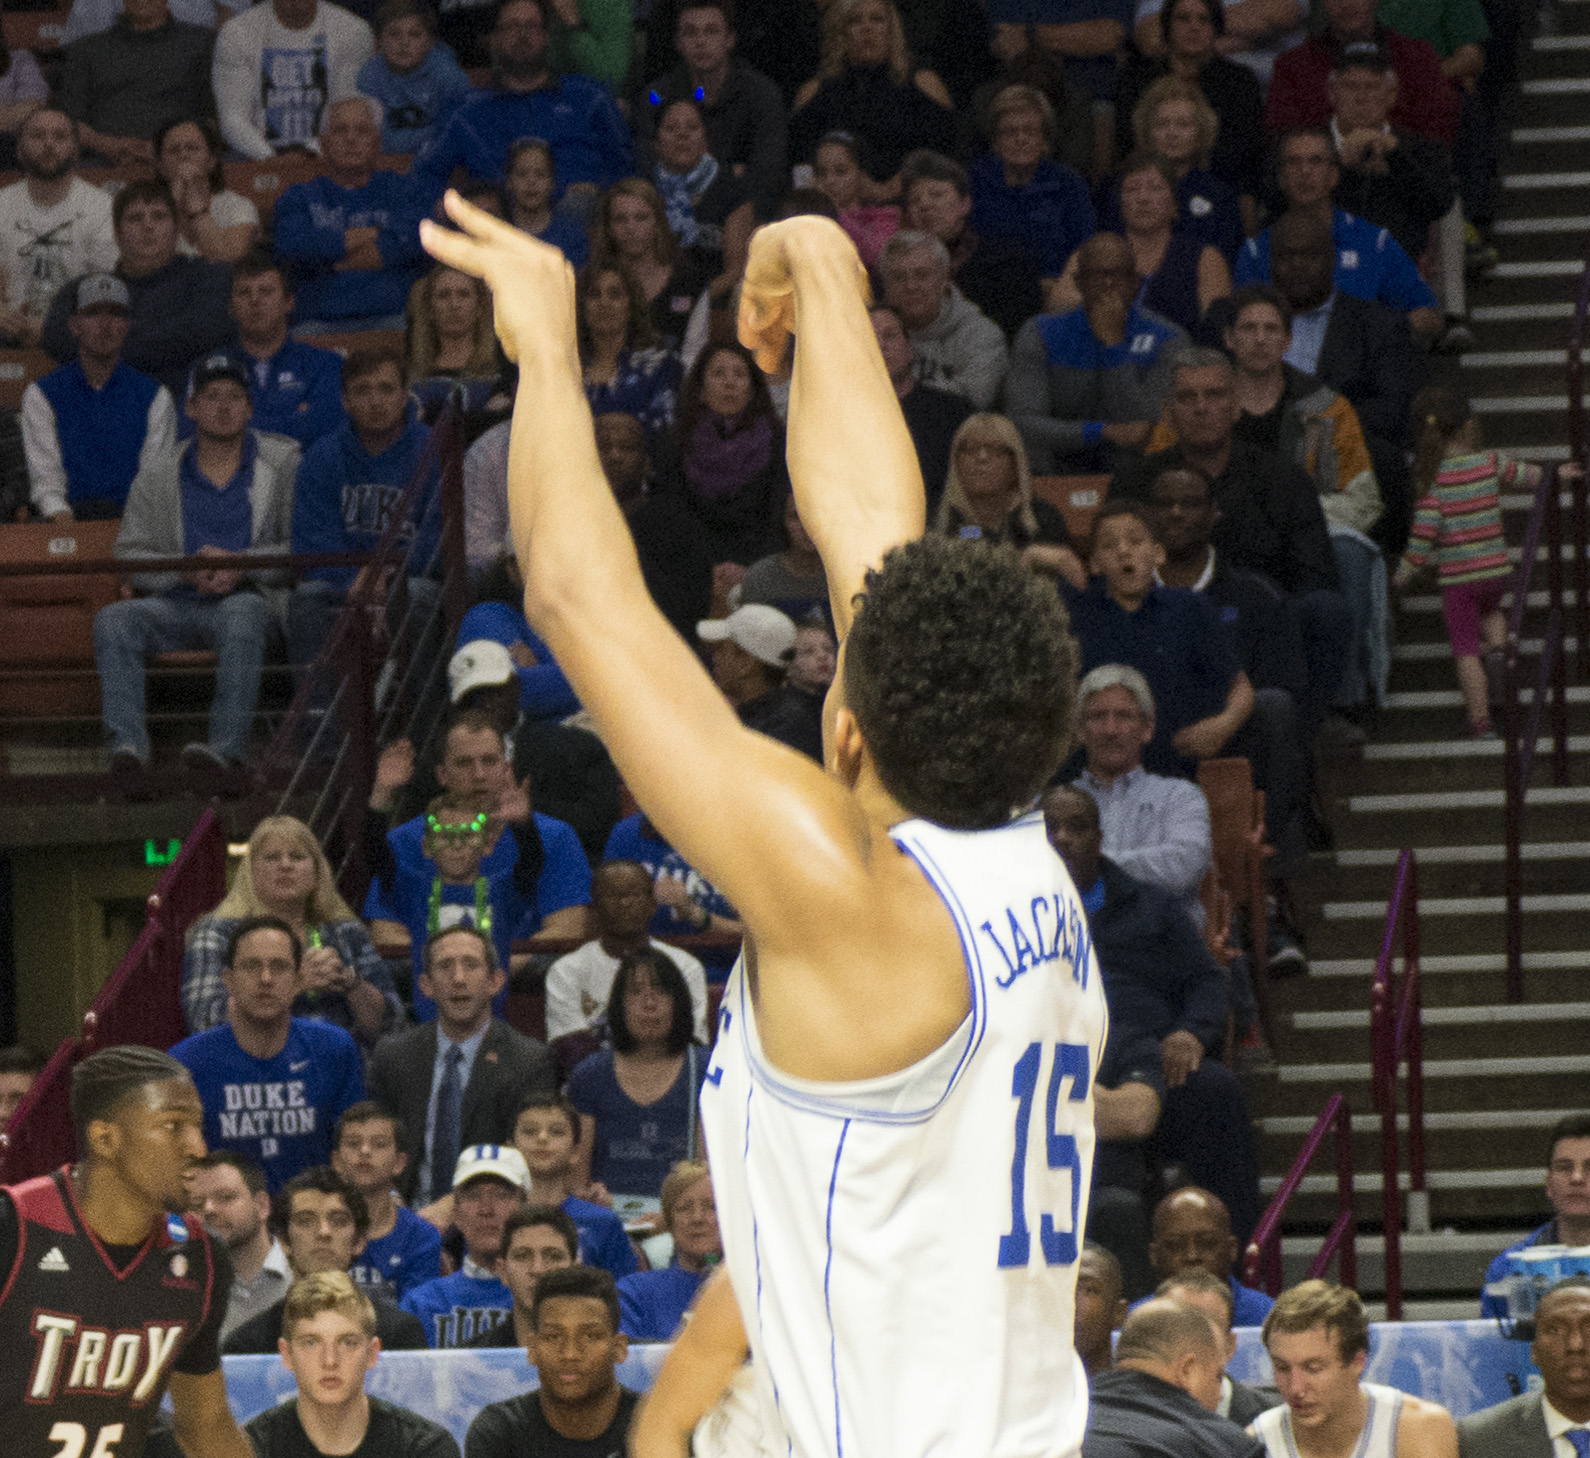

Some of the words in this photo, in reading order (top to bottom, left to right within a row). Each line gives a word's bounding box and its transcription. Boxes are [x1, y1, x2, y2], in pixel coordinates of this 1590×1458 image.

[219, 1108, 316, 1138] NATION
[224, 1080, 306, 1111] DUKE
[998, 1042, 1090, 1268] 15
[28, 1311, 184, 1402] TROY
